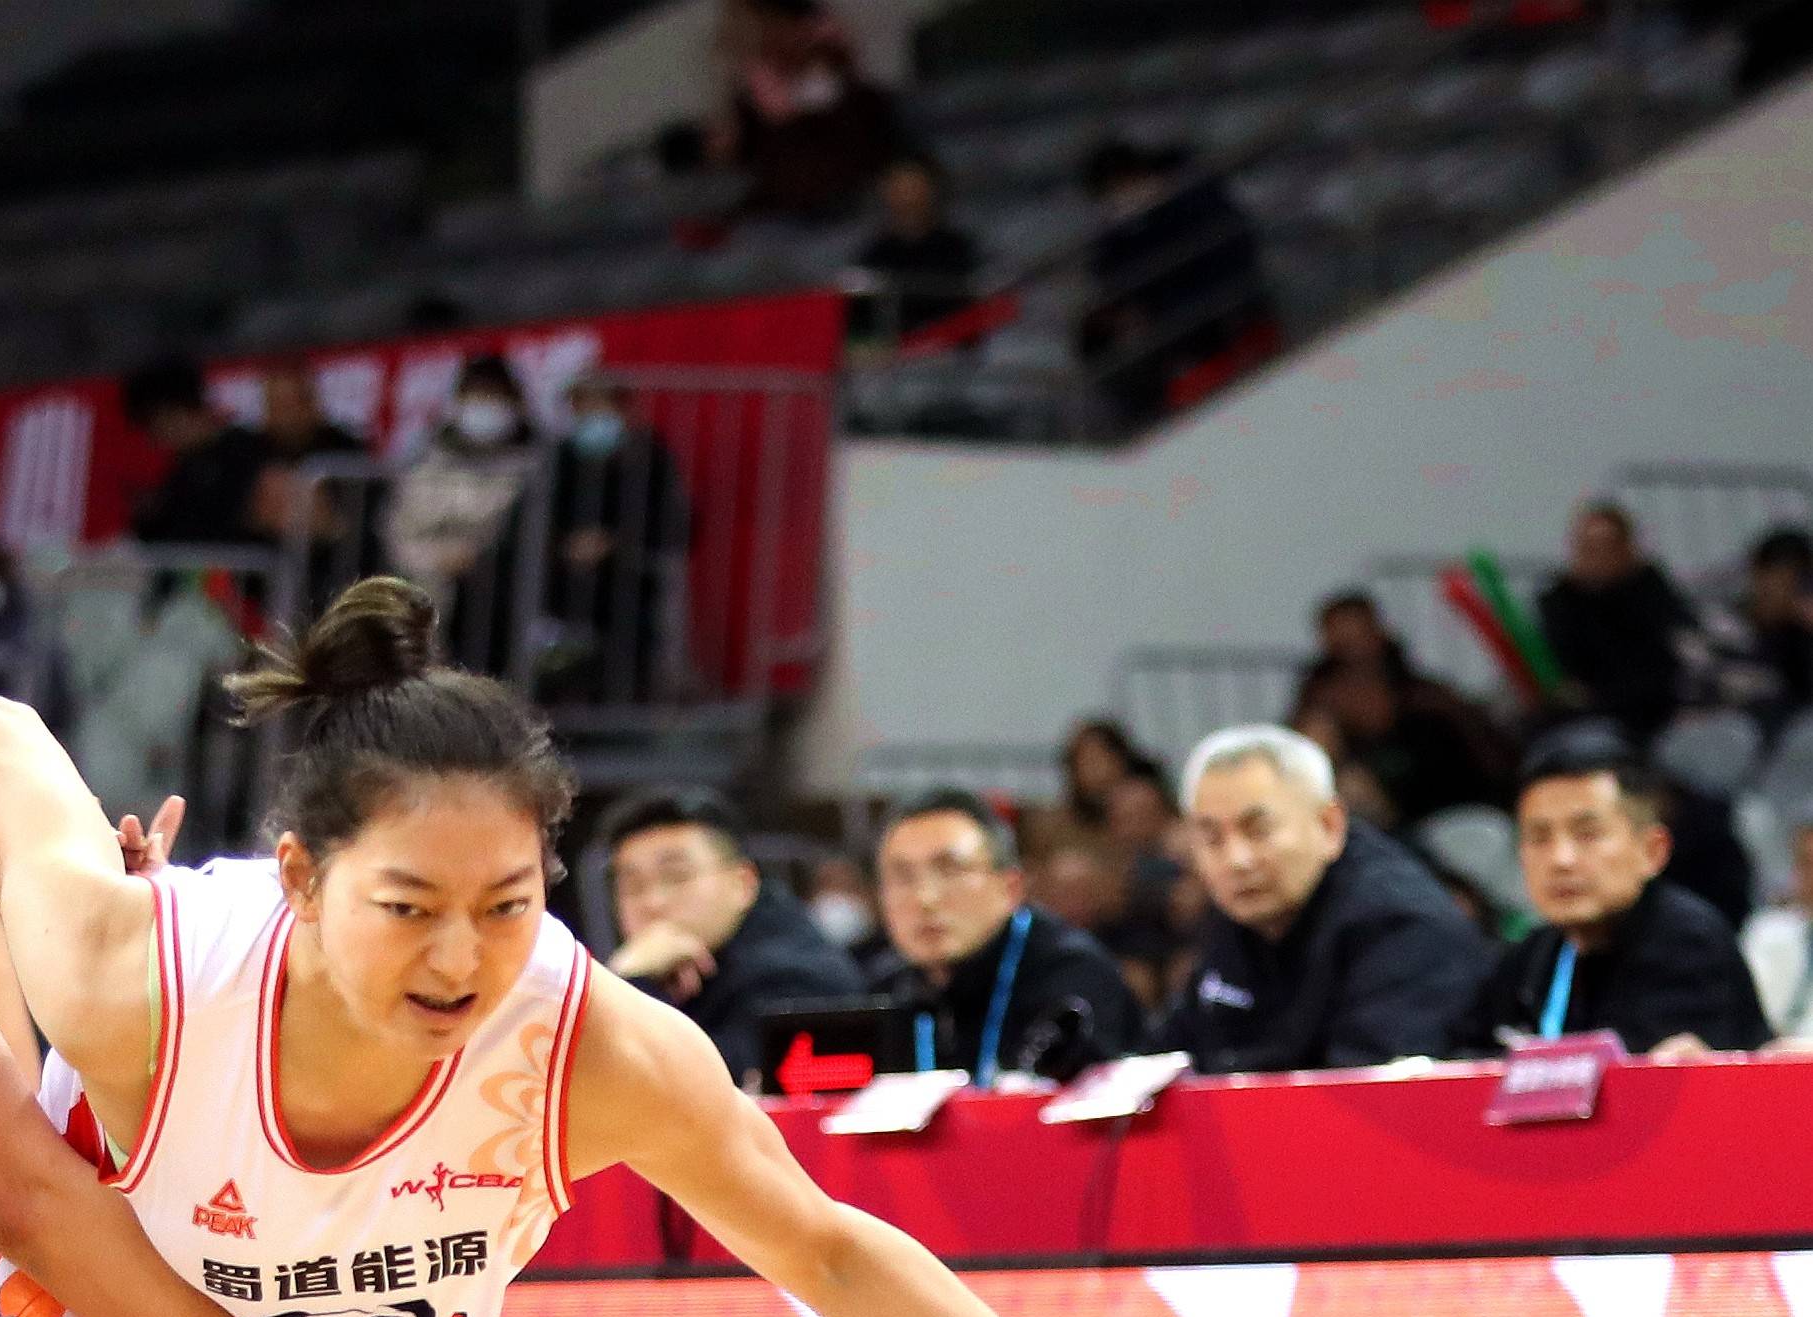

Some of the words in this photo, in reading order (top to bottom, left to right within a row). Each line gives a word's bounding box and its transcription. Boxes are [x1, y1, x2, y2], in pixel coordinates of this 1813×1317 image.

[192, 1204, 259, 1240] PEAK
[202, 1230, 488, 1302] 蜀道能源
